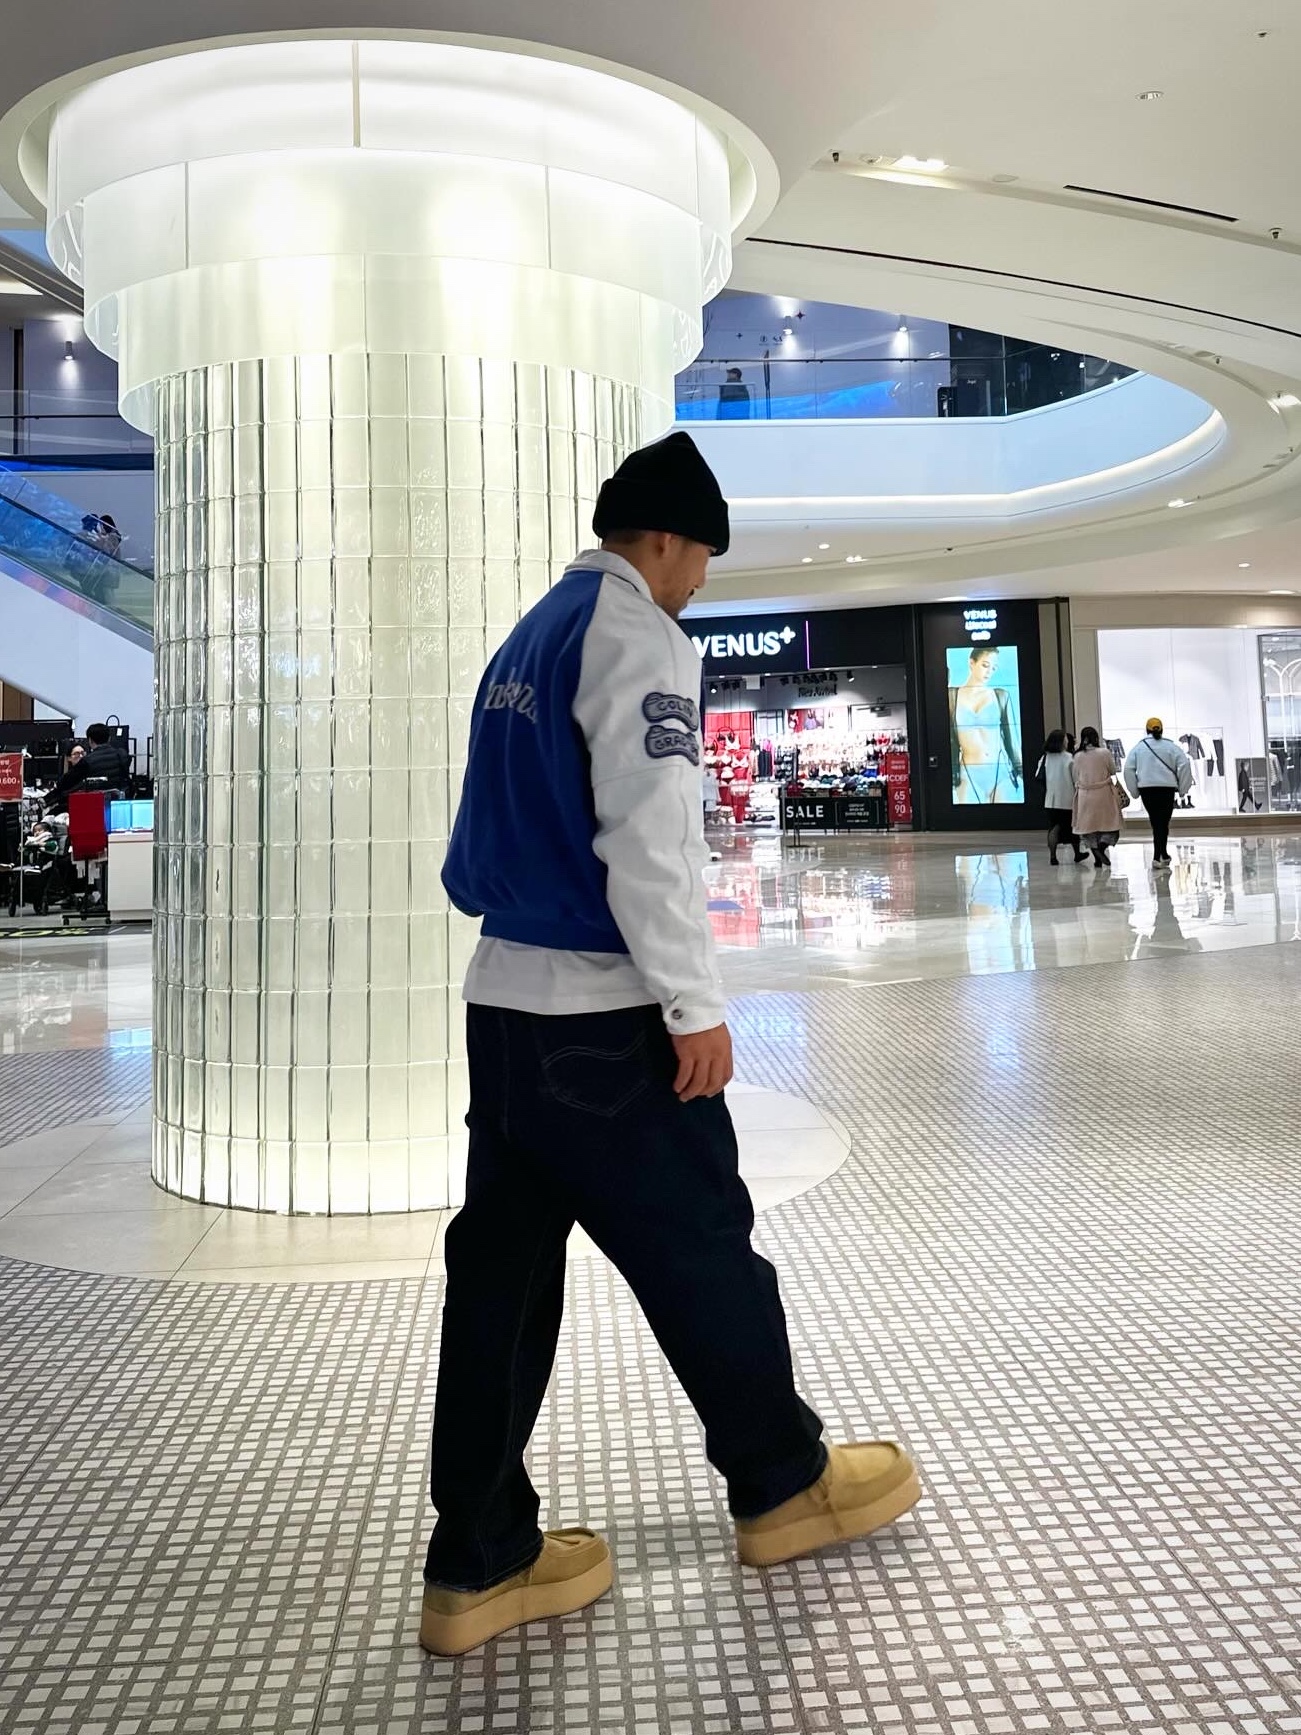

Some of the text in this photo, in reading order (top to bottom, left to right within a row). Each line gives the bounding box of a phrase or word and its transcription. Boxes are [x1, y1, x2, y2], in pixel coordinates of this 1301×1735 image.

[894, 791, 905, 801] 65
[786, 805, 824, 818] SALE
[894, 804, 906, 814] 90
